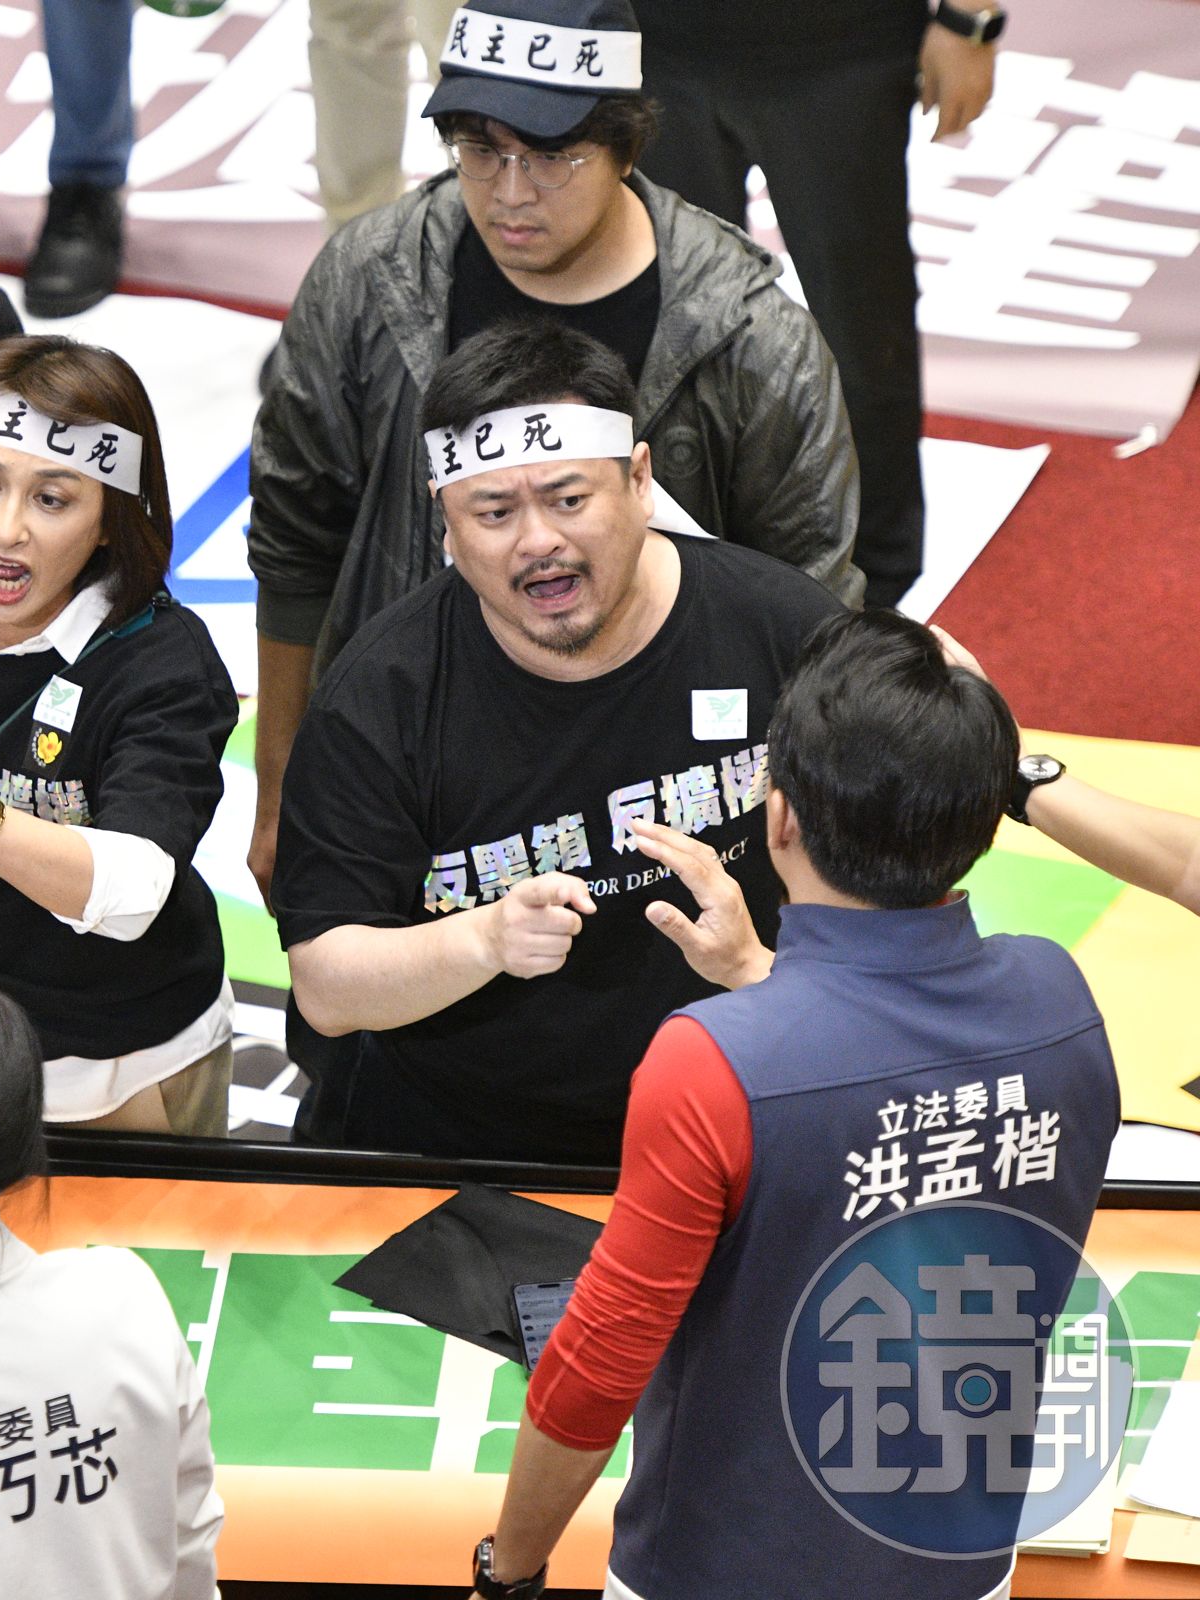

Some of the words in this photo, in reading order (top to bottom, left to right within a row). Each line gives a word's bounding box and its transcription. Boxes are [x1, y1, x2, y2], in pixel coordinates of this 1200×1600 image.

[450, 16, 603, 77] 民主已死
[428, 413, 562, 482] 主已死
[878, 1074, 1028, 1141] 立法委員
[842, 1110, 1062, 1222] 洪孟楷
